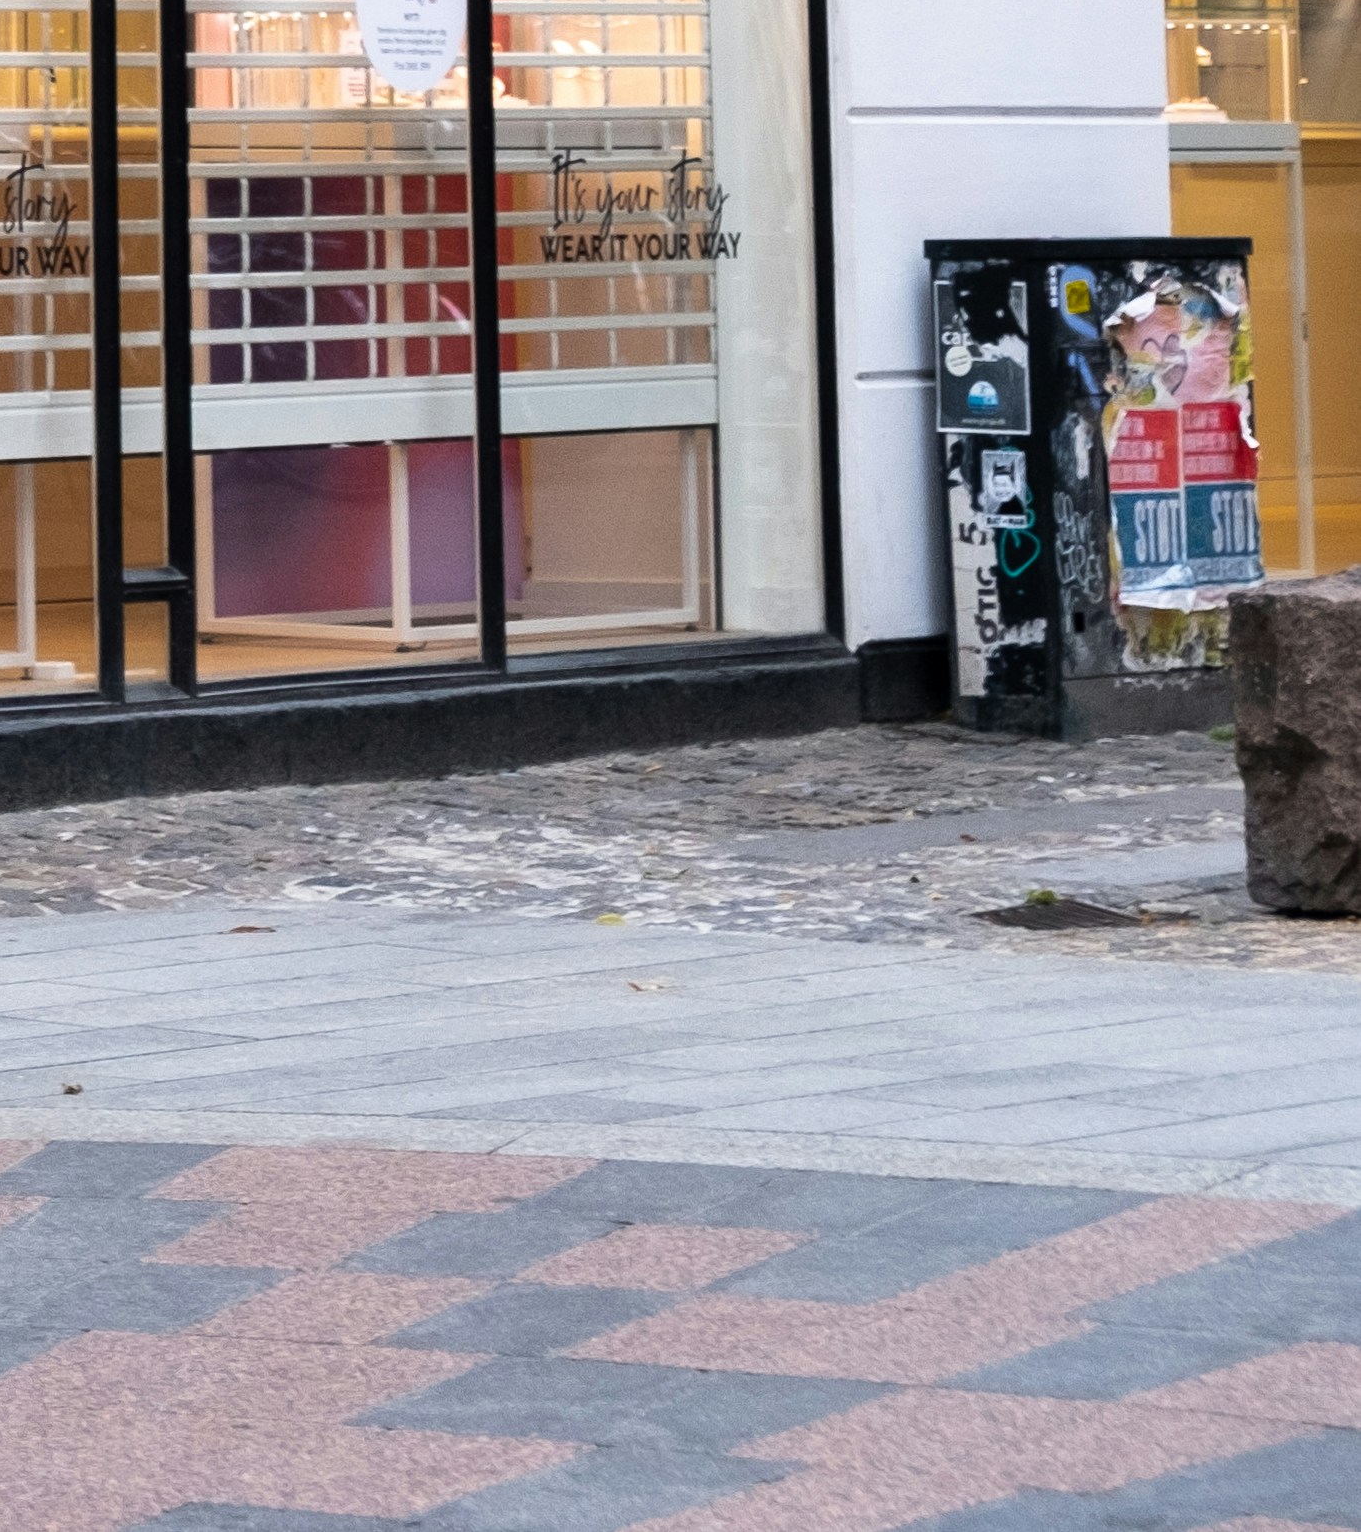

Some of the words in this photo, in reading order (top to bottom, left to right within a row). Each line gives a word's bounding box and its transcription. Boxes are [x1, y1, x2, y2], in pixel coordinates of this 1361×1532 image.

[4, 152, 77, 254] story
[551, 148, 587, 231] It's
[596, 183, 659, 242] your
[668, 149, 731, 242] story
[37, 245, 91, 277] WAY
[540, 234, 605, 263] WEAR
[609, 234, 629, 262] IT
[634, 233, 691, 261] YOUR
[697, 232, 742, 260] WAY
